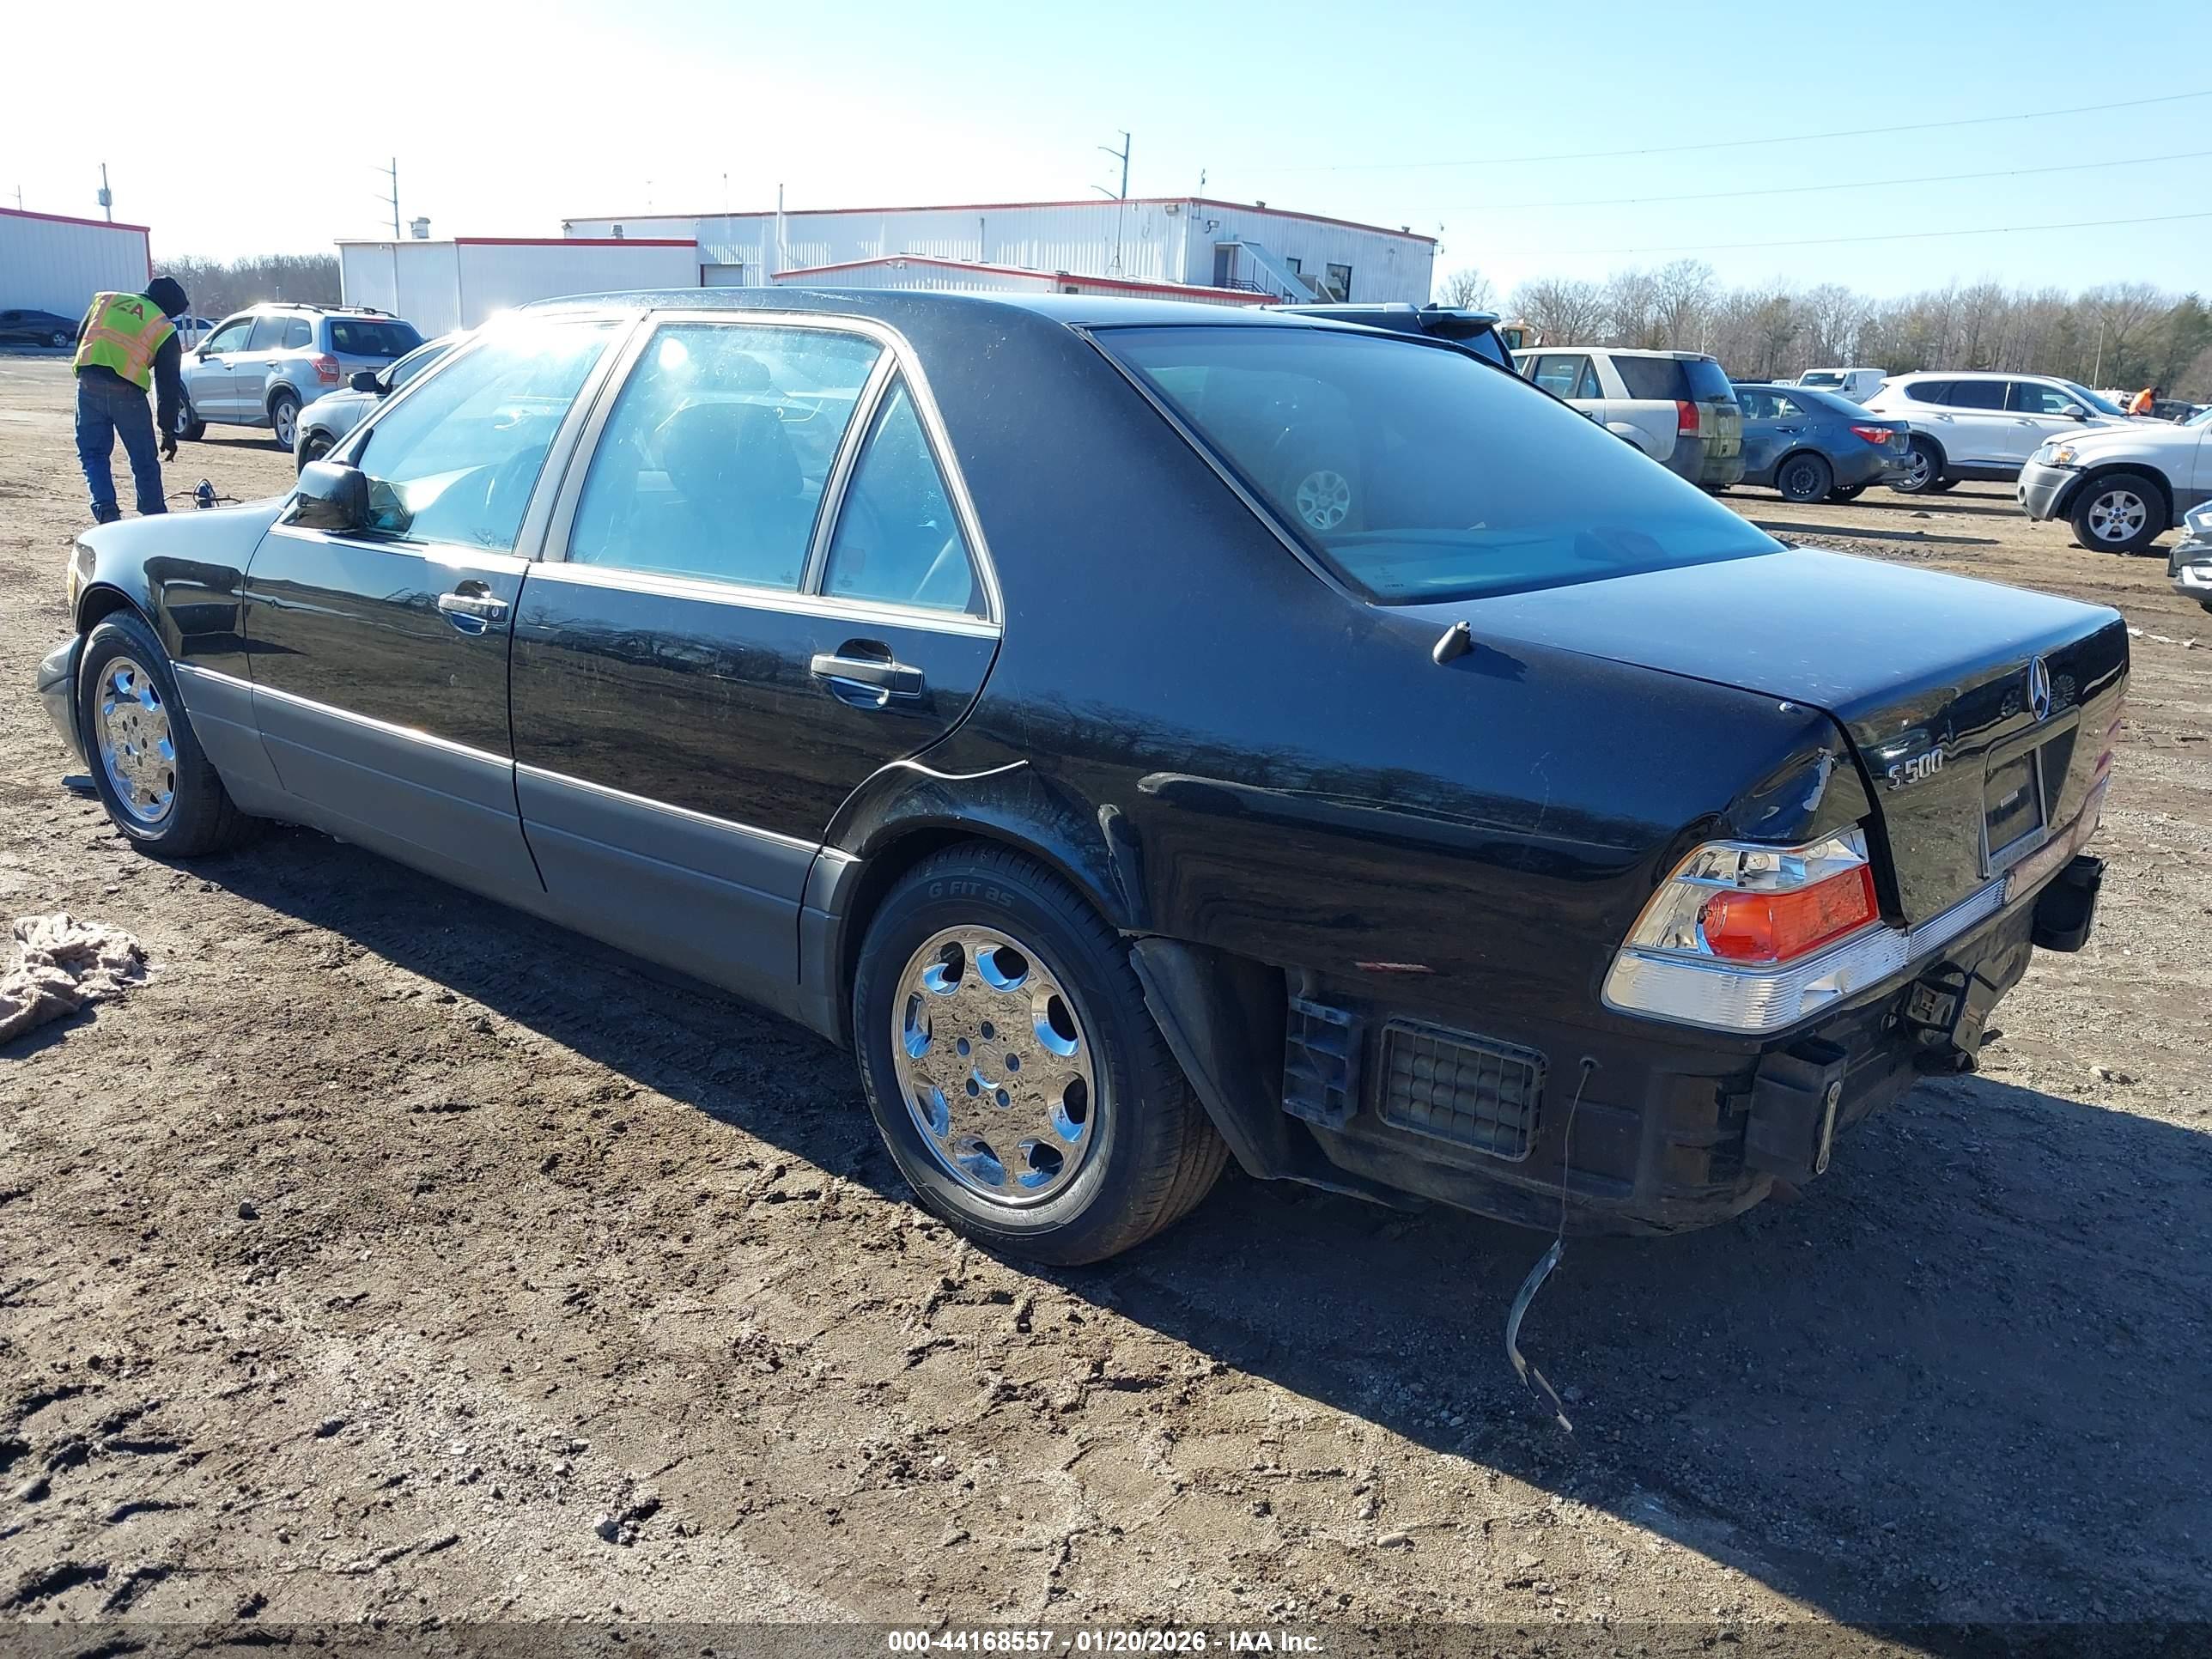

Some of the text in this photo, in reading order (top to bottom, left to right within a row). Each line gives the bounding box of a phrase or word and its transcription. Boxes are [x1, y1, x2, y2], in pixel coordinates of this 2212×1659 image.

[1905, 748, 1943, 784] 500
[928, 882, 942, 898] G
[950, 881, 981, 895] FIT
